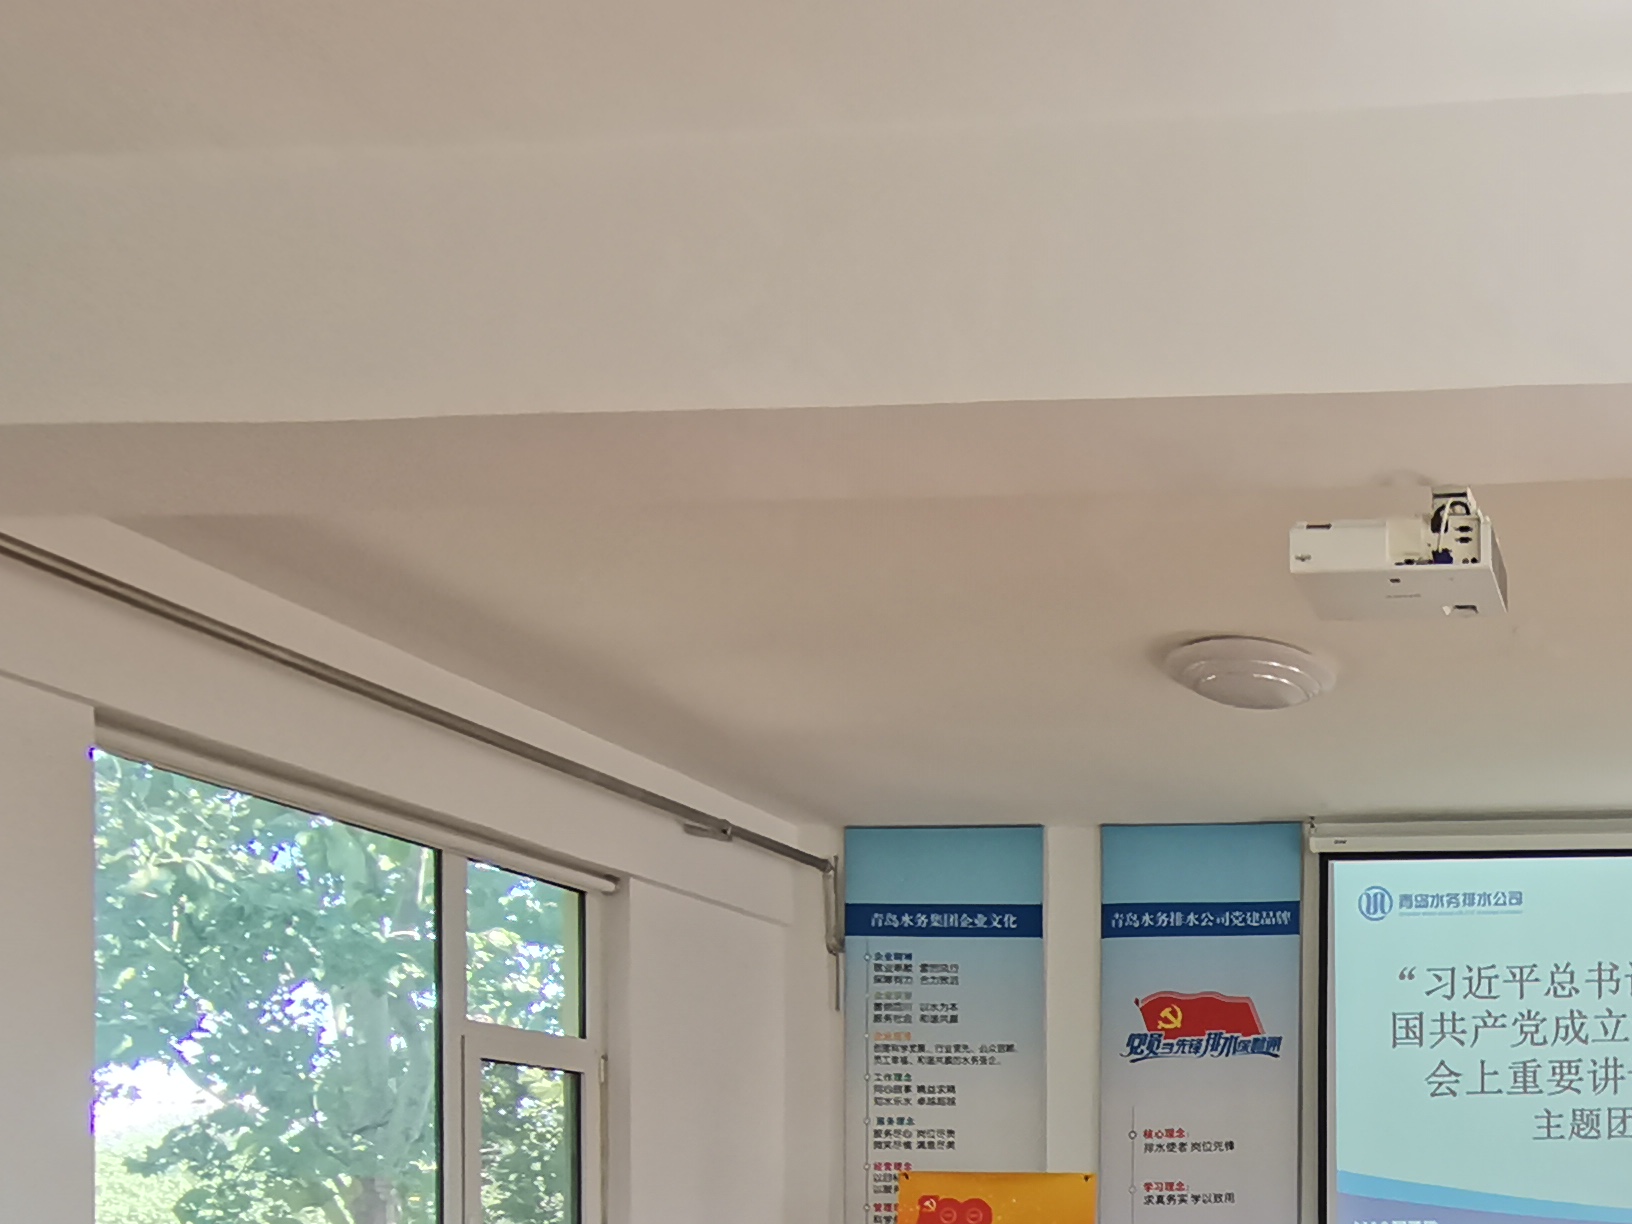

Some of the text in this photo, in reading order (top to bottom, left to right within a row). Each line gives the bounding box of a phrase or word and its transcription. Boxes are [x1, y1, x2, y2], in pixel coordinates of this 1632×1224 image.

[1398, 891, 1524, 909] 青岛水务排水公司
[870, 912, 1018, 929] 青岛水务集团企业文化
[1111, 910, 1292, 929] 青岛水务排水公司党建品牌
